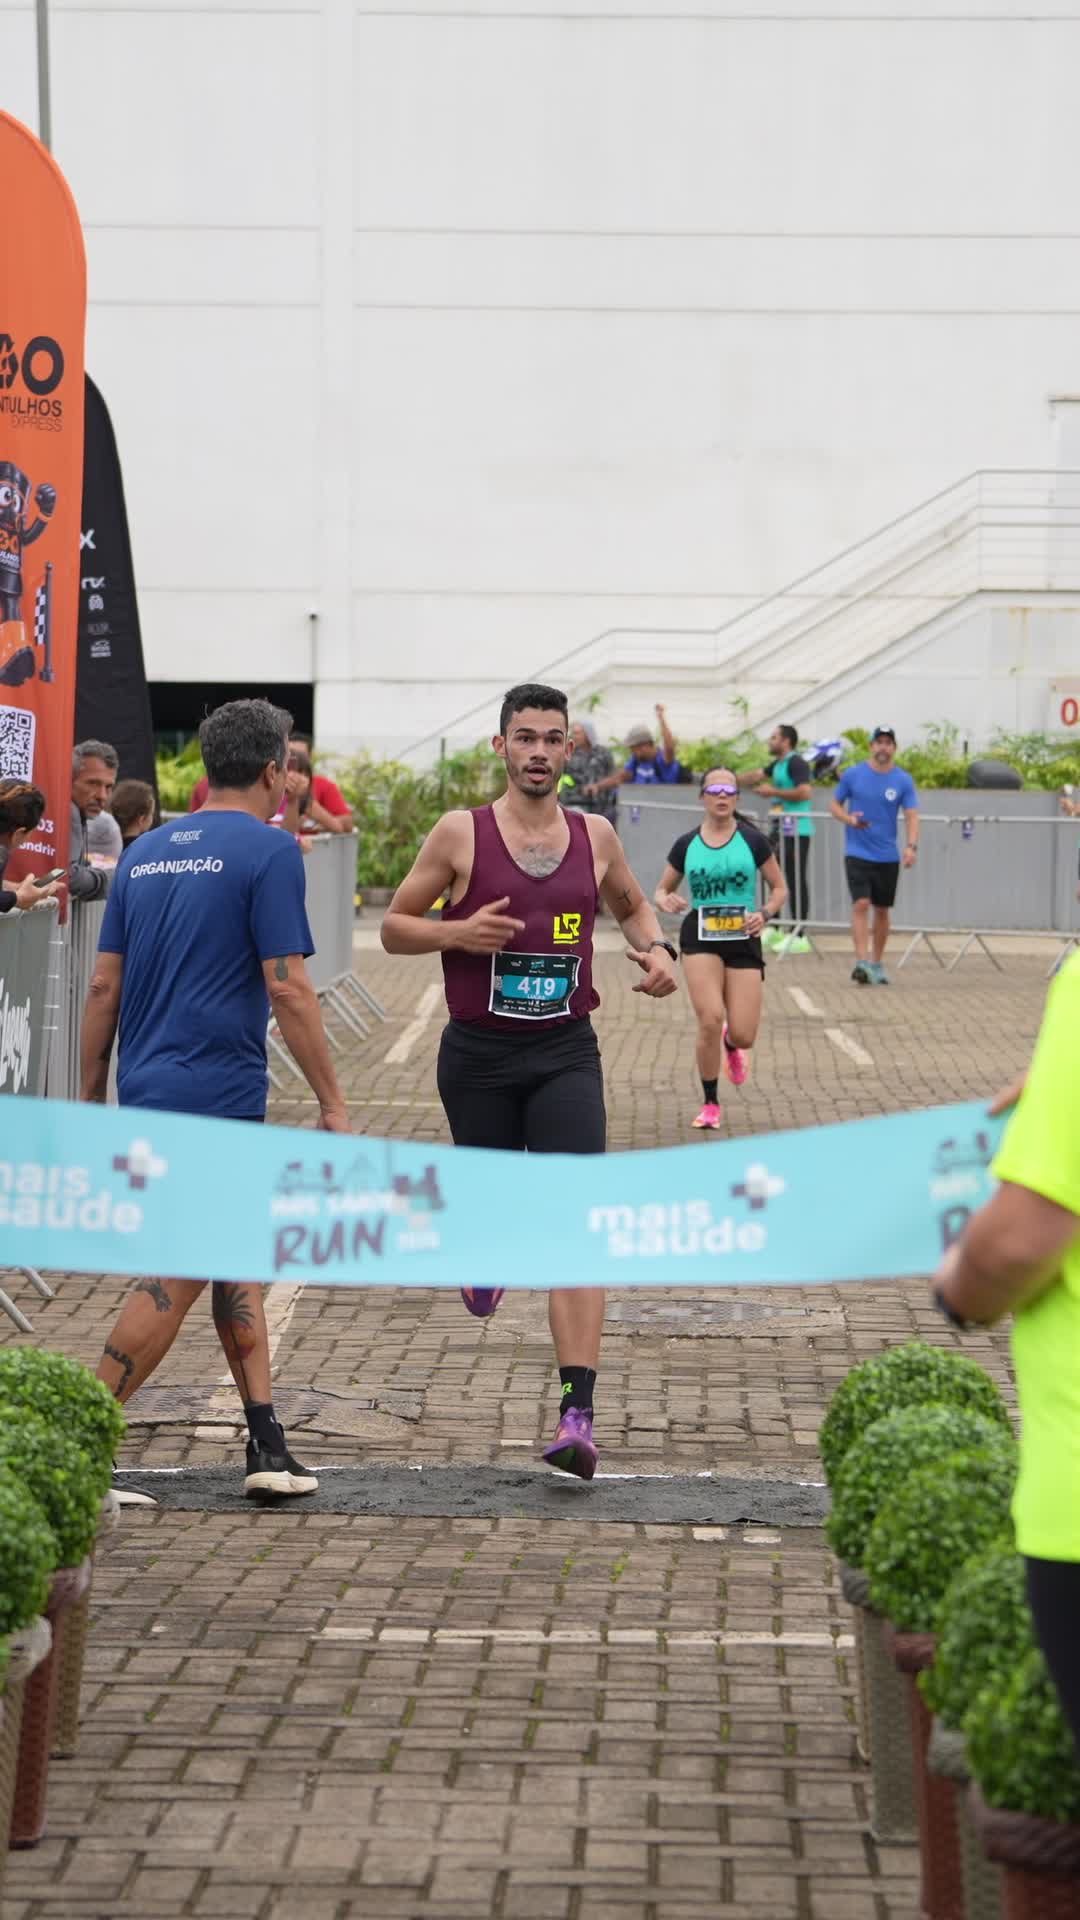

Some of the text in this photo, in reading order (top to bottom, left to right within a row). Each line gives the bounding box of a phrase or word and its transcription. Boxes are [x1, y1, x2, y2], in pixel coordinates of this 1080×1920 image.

[130, 856, 223, 879] ORGANIZAÇÃO
[517, 976, 556, 996] 419
[588, 1199, 712, 1233] mais
[275, 1217, 388, 1272] RUN
